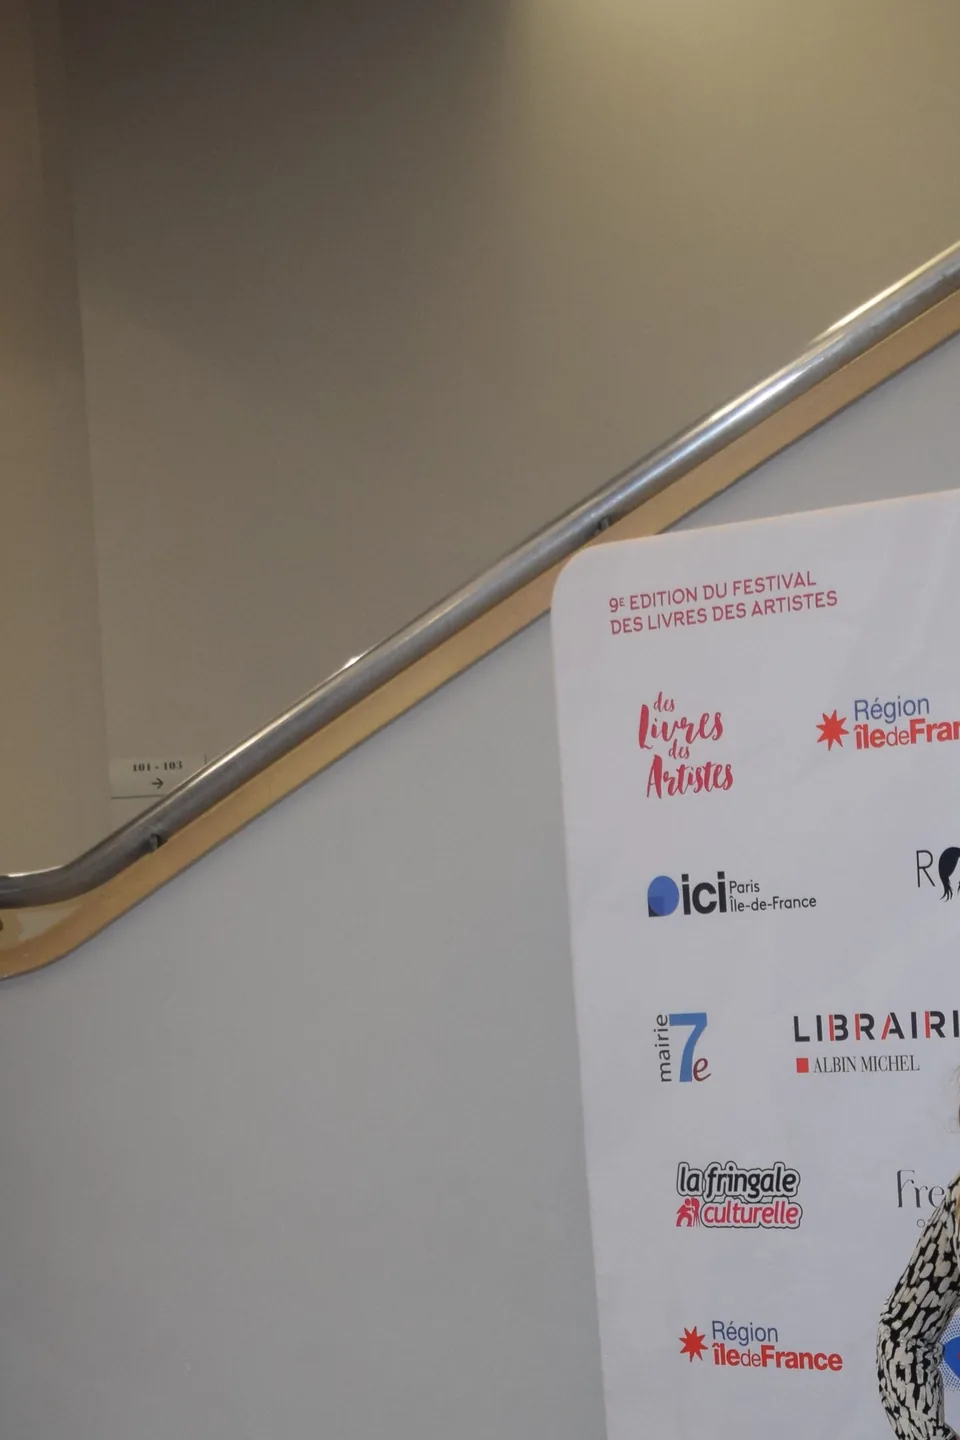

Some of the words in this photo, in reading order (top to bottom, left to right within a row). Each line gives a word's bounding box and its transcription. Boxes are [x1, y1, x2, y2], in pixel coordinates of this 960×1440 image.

[630, 587, 697, 610] EDITION
[703, 583, 727, 600] DU
[733, 571, 816, 596] FESTIVAL
[610, 616, 643, 635] DES
[648, 608, 707, 630] LIVRES
[712, 603, 746, 621] DES
[751, 590, 837, 616] ARTISTES
[654, 692, 674, 712] des
[855, 696, 929, 724] Région
[639, 699, 723, 749] Livres
[669, 739, 689, 759] des
[647, 754, 733, 799] Artistes
[682, 871, 727, 915] ici
[730, 881, 760, 893] Paris
[729, 896, 816, 912] Île-de-France
[654, 1015, 672, 1082] mairie
[669, 1012, 711, 1082] 7e
[815, 1057, 856, 1072] ALBIN
[861, 1055, 920, 1071] MICHEL
[680, 1167, 700, 1192] la
[704, 1165, 797, 1200] fringale
[703, 1202, 803, 1229] culturelle
[712, 1321, 778, 1346] Région
